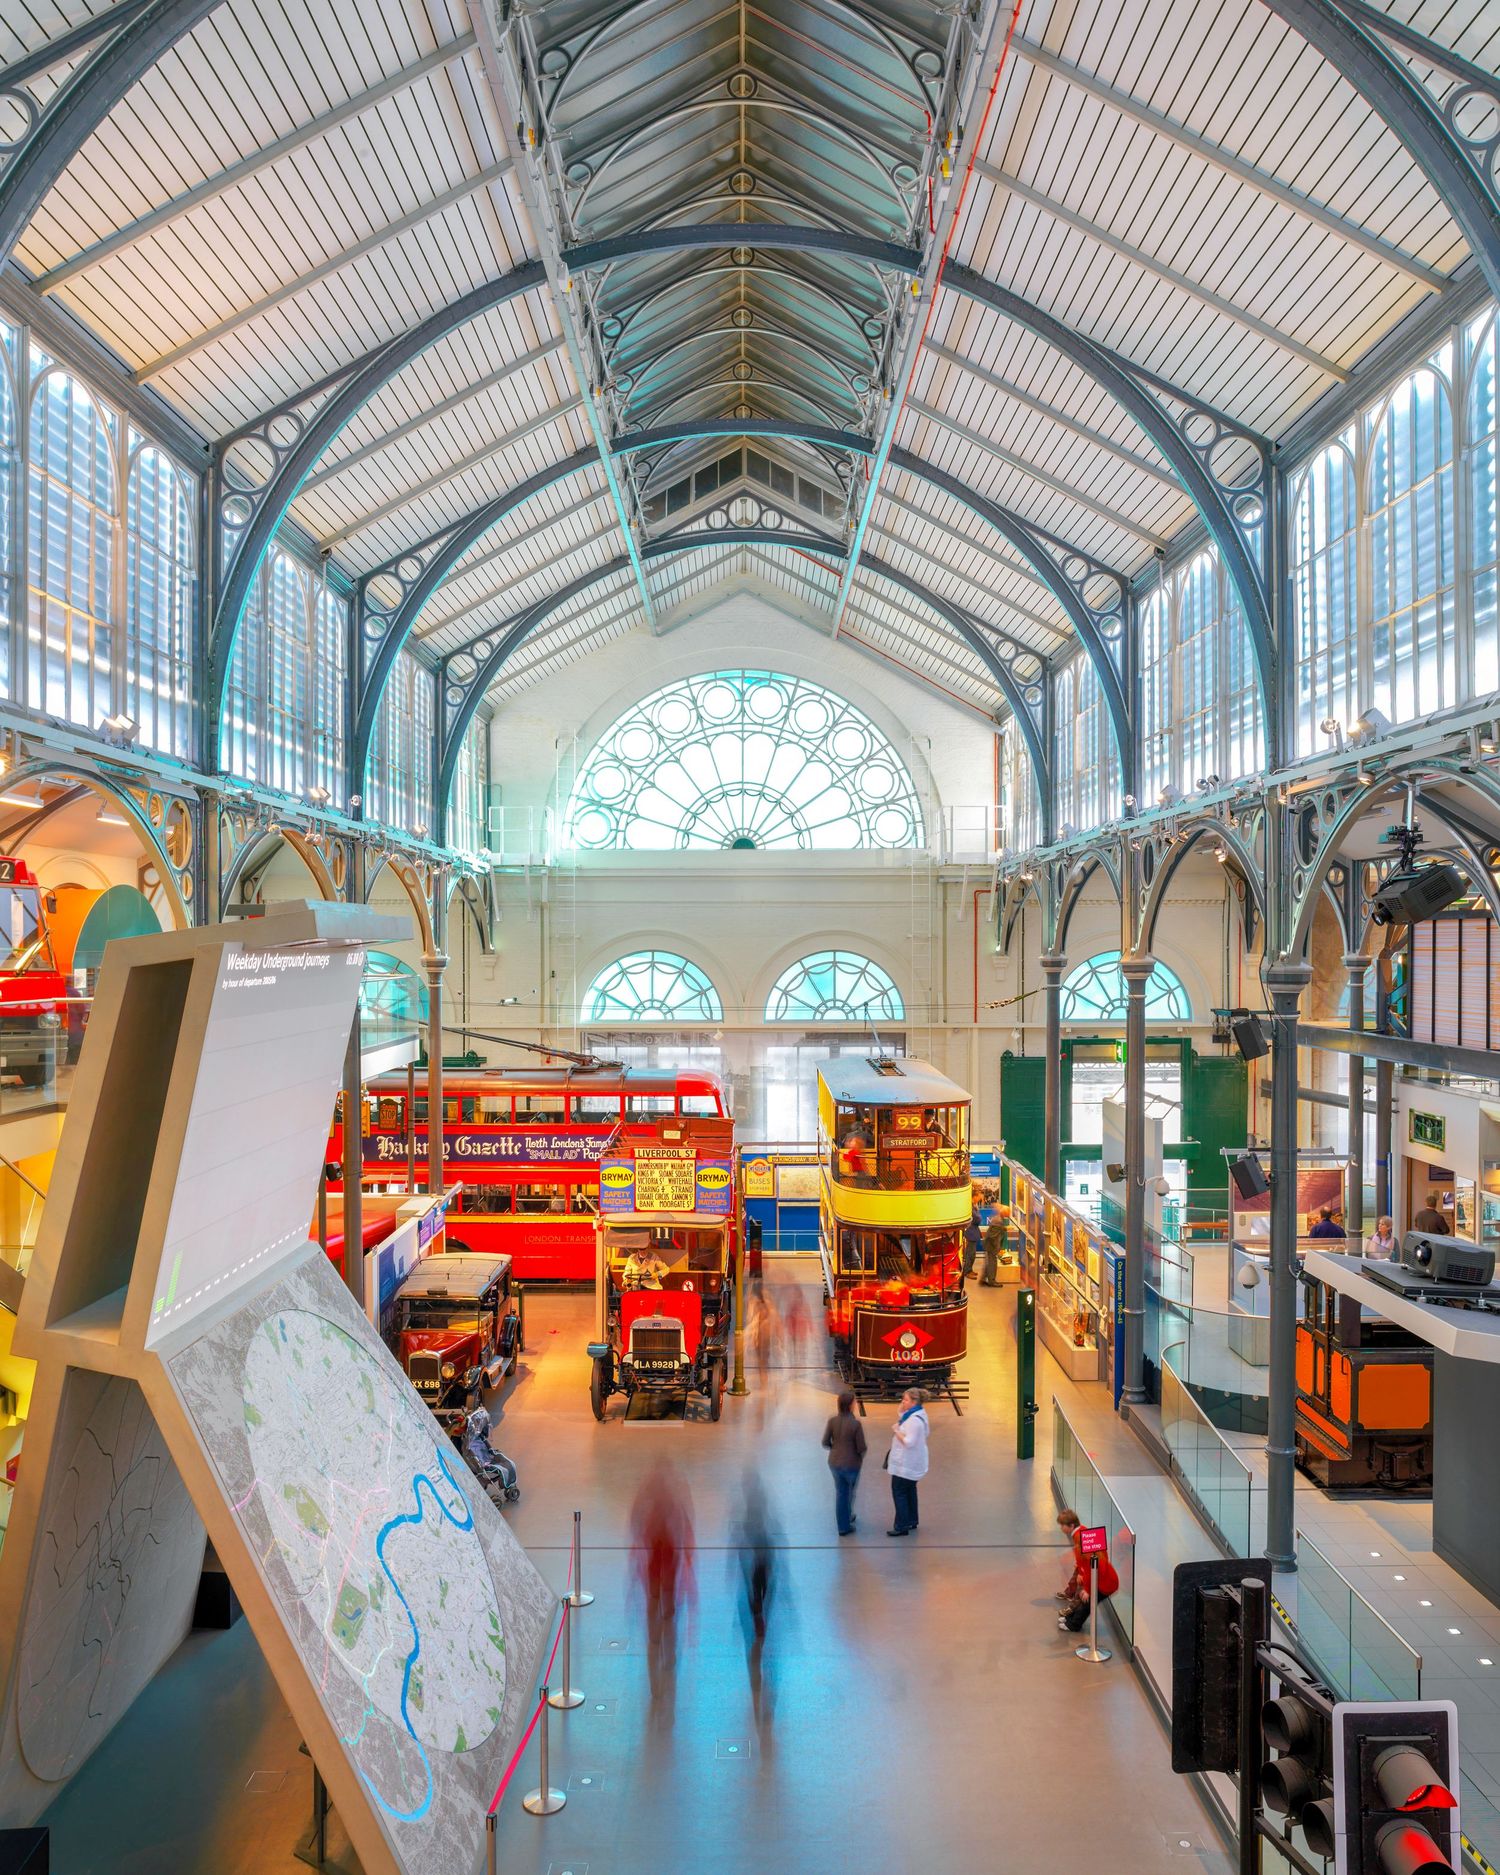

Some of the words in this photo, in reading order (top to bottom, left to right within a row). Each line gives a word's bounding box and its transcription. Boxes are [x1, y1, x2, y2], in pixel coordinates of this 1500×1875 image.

[227, 953, 262, 972] Weekday
[262, 952, 306, 971] Underground
[303, 952, 330, 969] journeys
[228, 979, 239, 988] hour
[381, 1109, 396, 1120] STOP
[897, 1116, 922, 1130] 99
[455, 1135, 522, 1156] Gazette
[525, 1137, 548, 1148] North
[551, 1136, 585, 1149] London's
[637, 1149, 681, 1158] LIVERPOOL
[601, 1173, 634, 1182] BRYMAY
[696, 1174, 730, 1183] BRYMAY
[749, 1177, 771, 1185] BUSES
[637, 1185, 660, 1193] CHARING
[671, 1185, 694, 1193] STRAND
[655, 1227, 670, 1239] 11
[525, 1234, 562, 1244] LONDON
[1117, 1261, 1124, 1270] On
[1026, 1294, 1033, 1305] 9
[639, 1360, 651, 1369] LA
[651, 1360, 674, 1369] 9928
